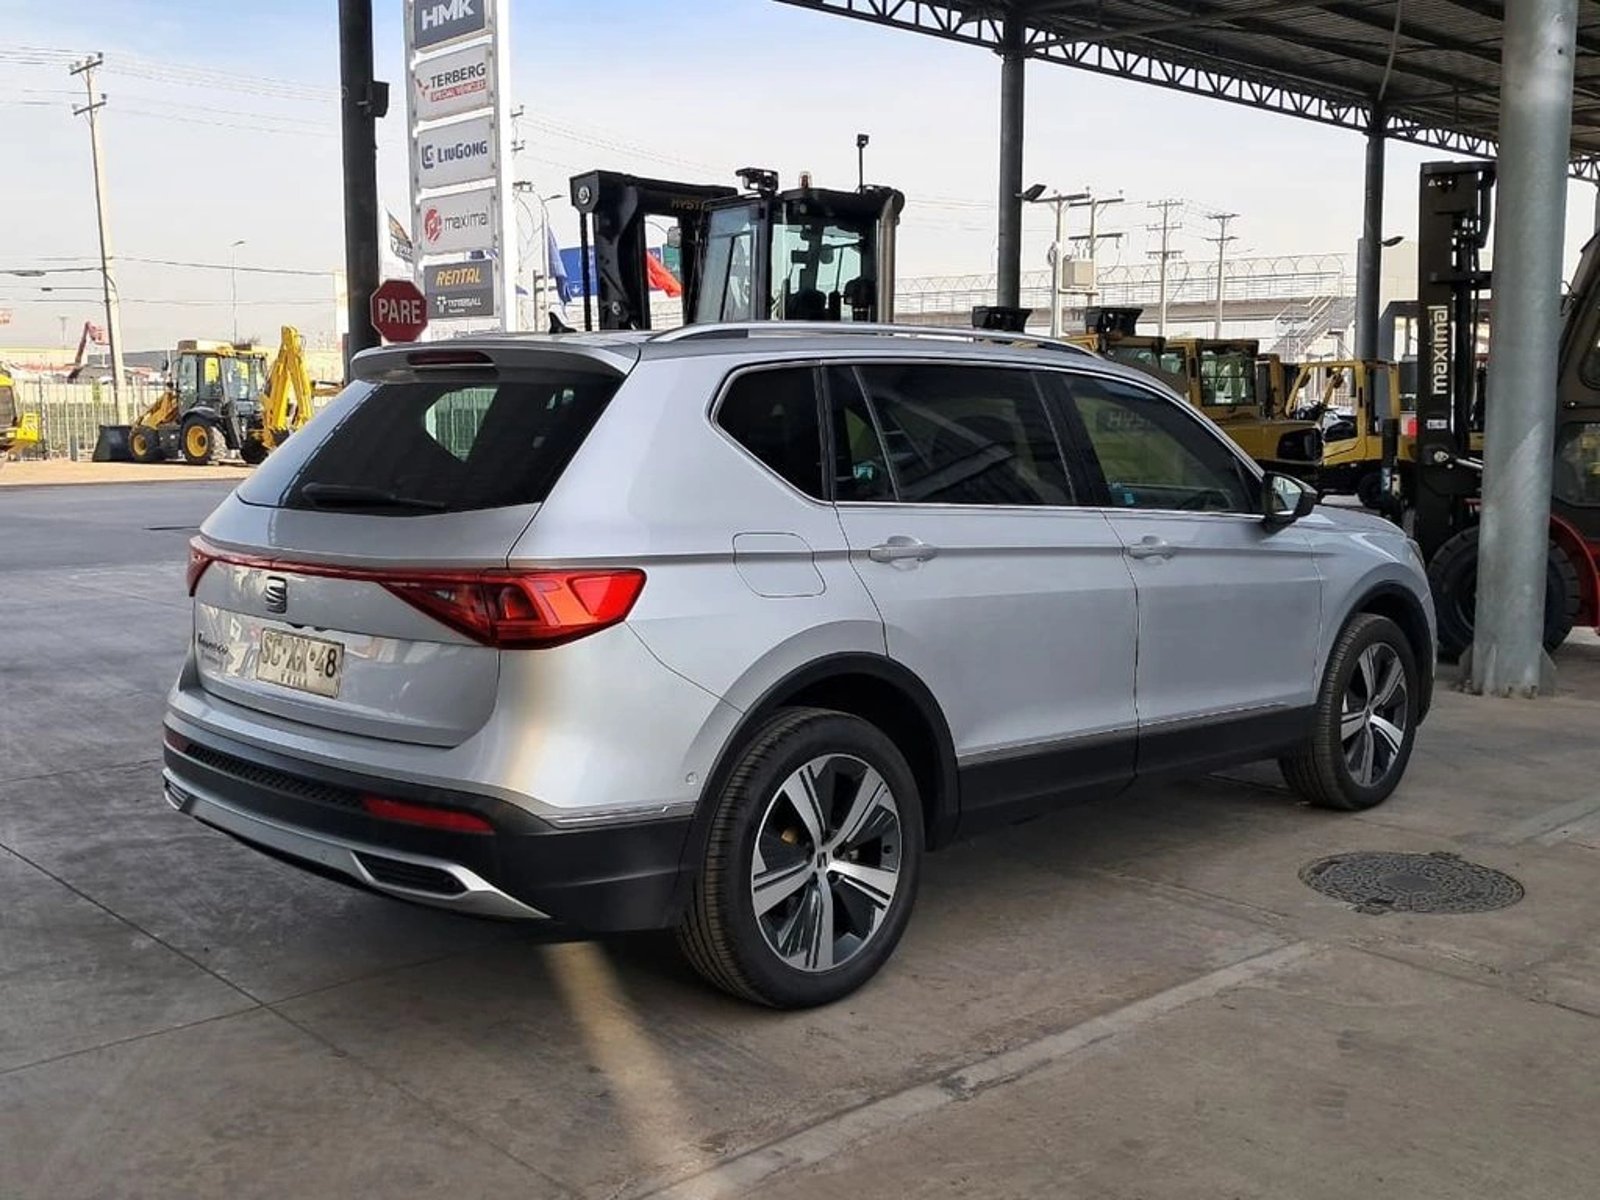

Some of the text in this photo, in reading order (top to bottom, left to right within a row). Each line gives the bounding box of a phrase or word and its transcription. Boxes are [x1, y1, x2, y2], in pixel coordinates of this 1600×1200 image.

[421, 0, 475, 31] HMK
[430, 62, 486, 89] TERBERG
[378, 298, 421, 324] PARE
[1427, 305, 1448, 394] maximal
